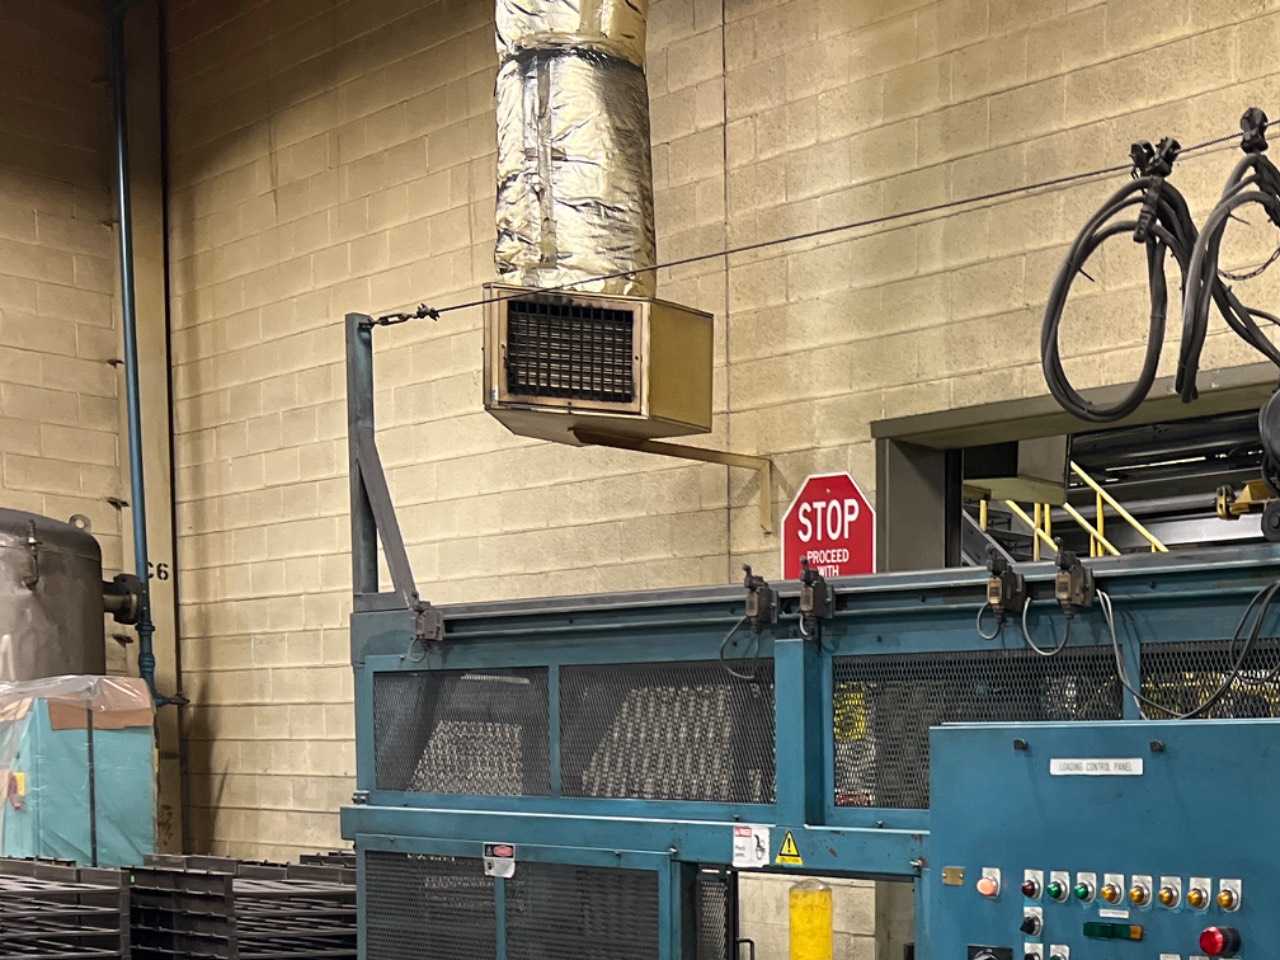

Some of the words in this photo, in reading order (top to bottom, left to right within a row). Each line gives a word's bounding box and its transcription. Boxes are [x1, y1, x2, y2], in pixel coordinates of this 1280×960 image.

[797, 498, 860, 543] STOP
[807, 548, 849, 564] PROCEED
[817, 565, 839, 577] WITH
[1086, 761, 1111, 772] CONTROL
[1113, 762, 1133, 772] PANEL
